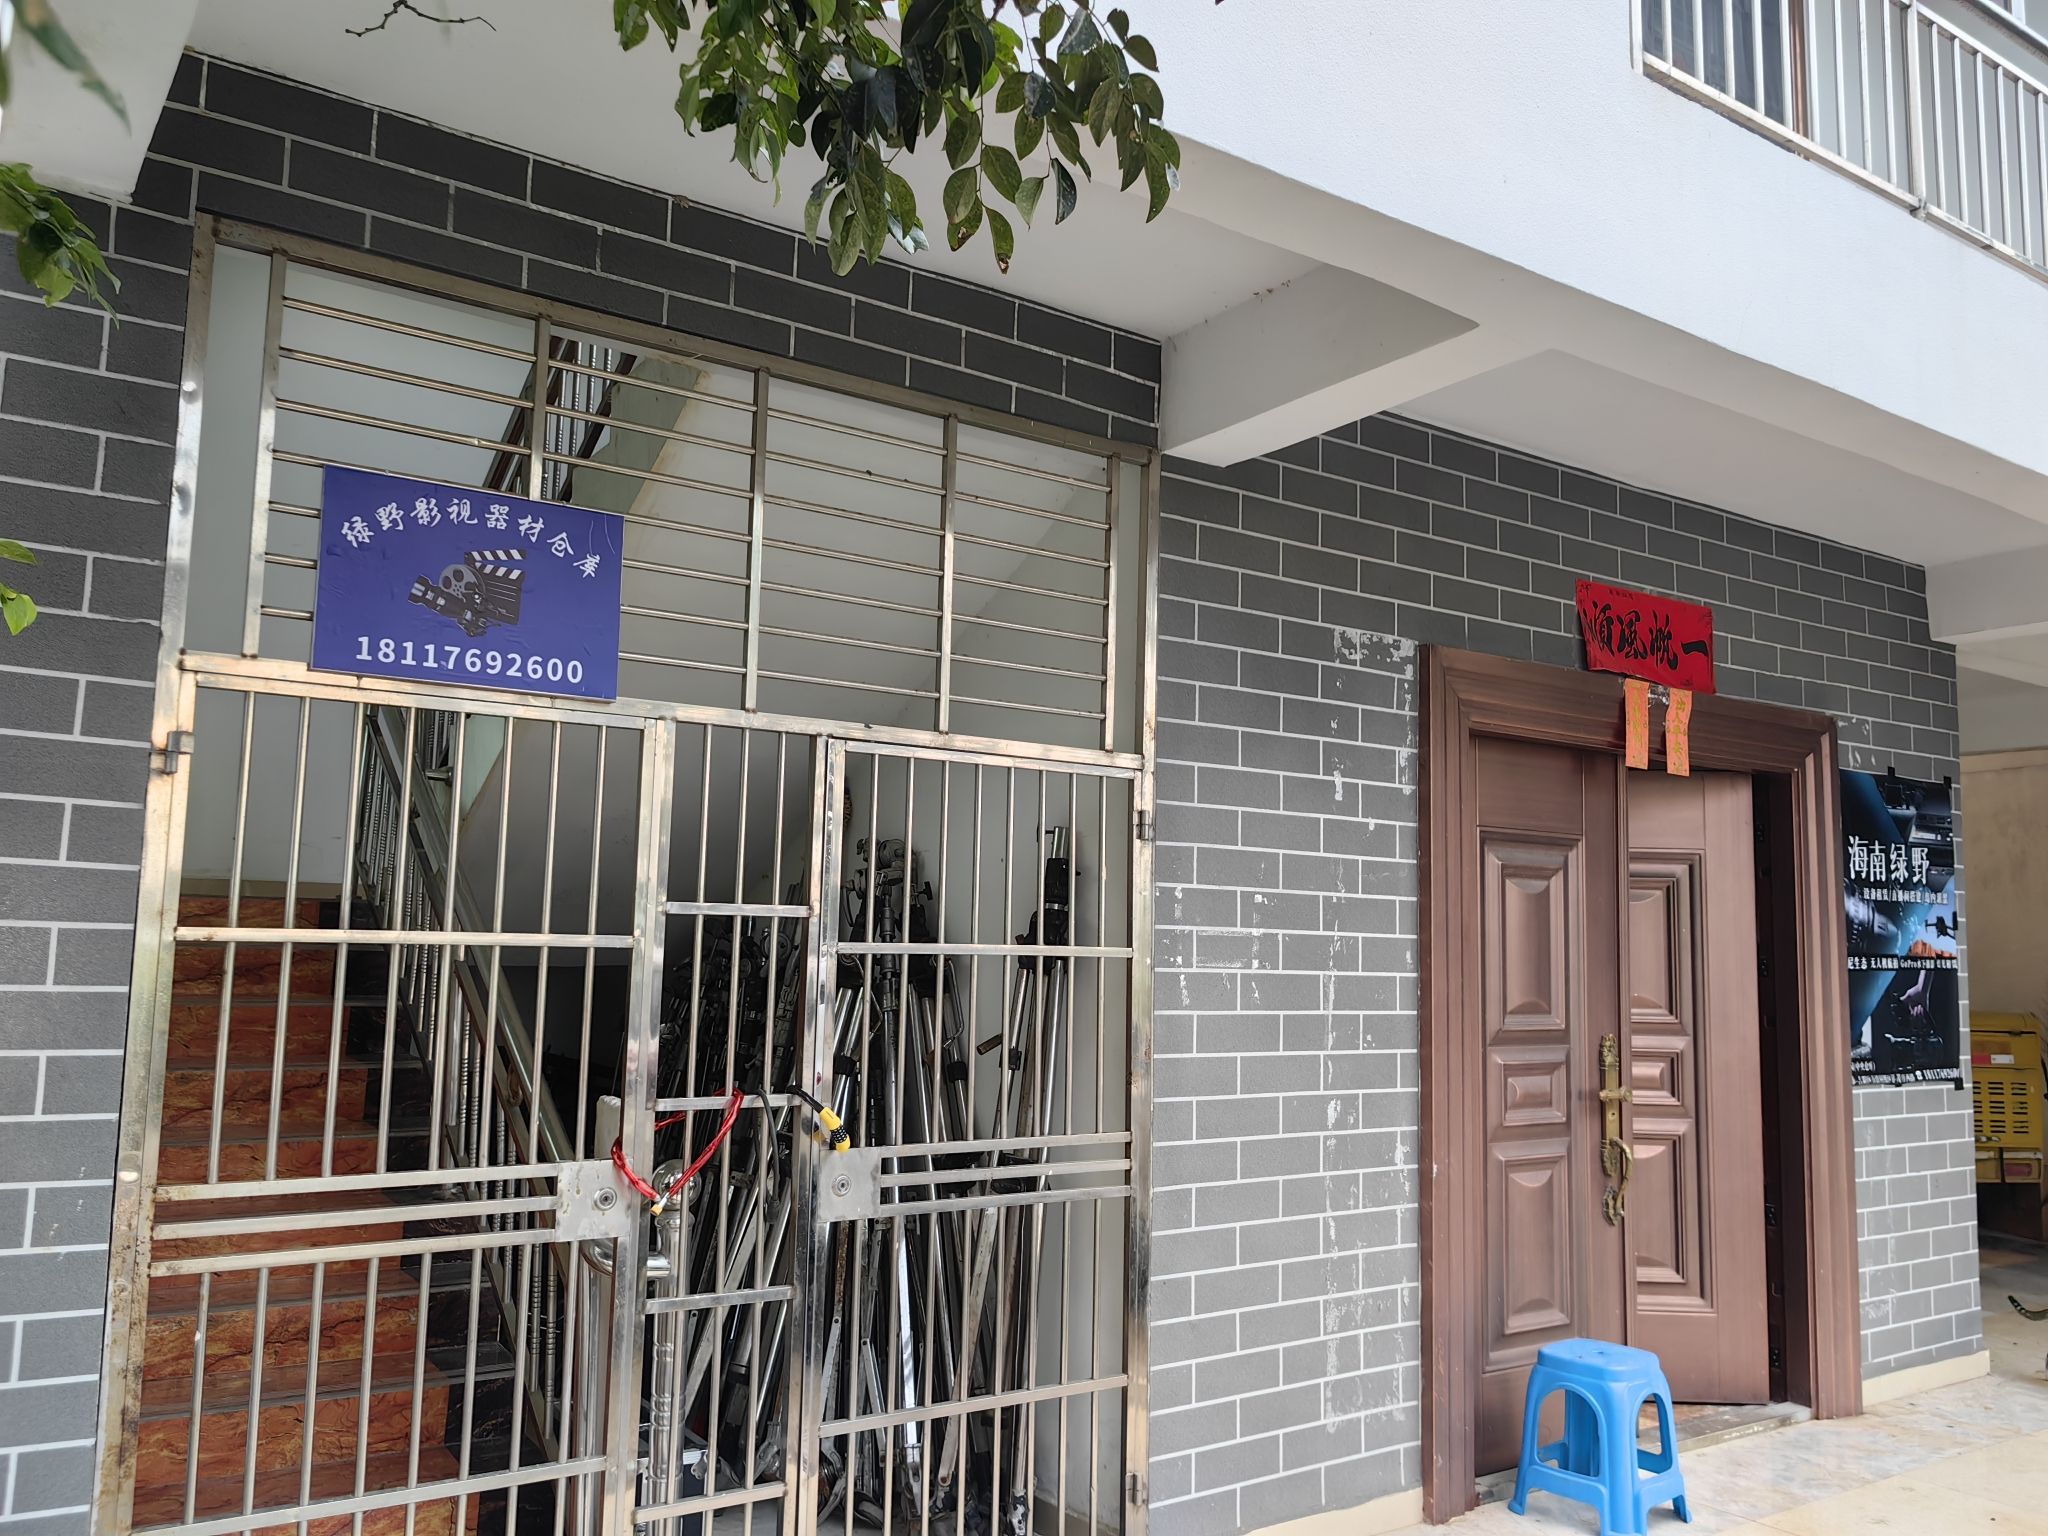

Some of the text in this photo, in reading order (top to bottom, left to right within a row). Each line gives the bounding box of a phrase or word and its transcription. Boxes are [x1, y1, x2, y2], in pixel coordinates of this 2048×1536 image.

[341, 498, 600, 578] 绿野影视器材仓库
[355, 636, 583, 683] 18117692600
[1848, 835, 1930, 885] 海南绿野
